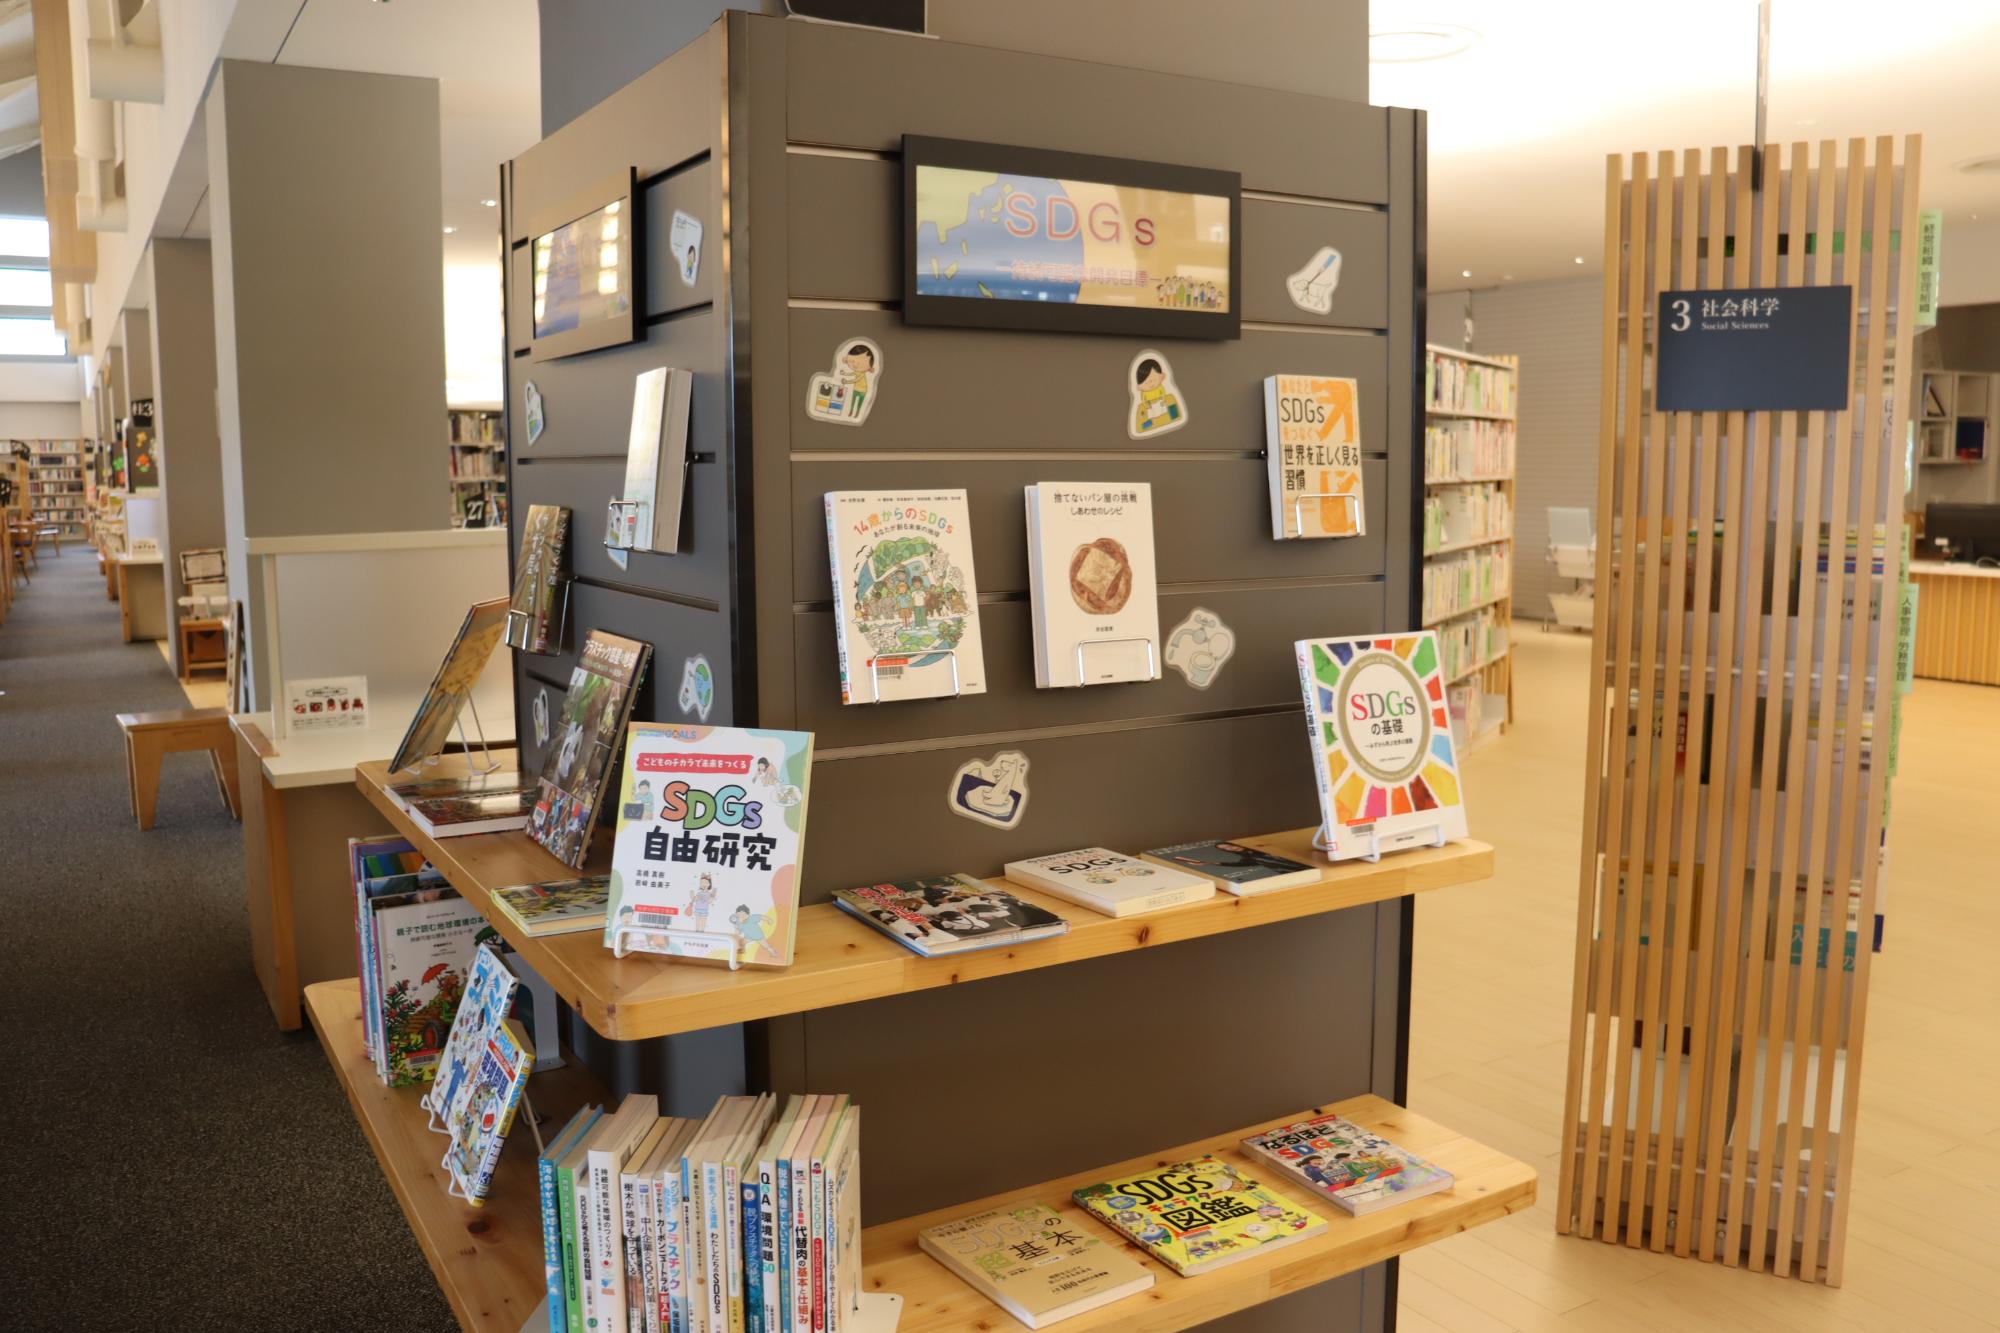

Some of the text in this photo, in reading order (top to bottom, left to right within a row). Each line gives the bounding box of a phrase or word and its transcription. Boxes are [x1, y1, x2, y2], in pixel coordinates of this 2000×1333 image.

[1004, 192, 1157, 247] SDGs
[1670, 299, 1692, 332] 3
[1701, 297, 1780, 318] 社会科学
[1701, 321, 1769, 331] Social Sciences
[1281, 398, 1325, 424] SDGs
[1284, 444, 1359, 467] 世界を正しく見る
[1286, 469, 1306, 491] 習慣
[467, 501, 484, 520] 27
[1054, 492, 1137, 503] 捨てないパン屋の挑戦
[854, 507, 954, 535] 14歳からのSDGs
[1071, 507, 1123, 516] しあわせのレシピ
[1351, 690, 1416, 721] SDGs
[1371, 718, 1404, 736] の基礎
[643, 758, 747, 769] こどものチカラで未来をつくる
[661, 780, 763, 830] SDGs
[644, 825, 778, 872] 自由研究
[1049, 856, 1128, 875] SDGs
[396, 916, 485, 936] 親子で読む地球環境の本
[1259, 1124, 1337, 1151] なるほど
[1277, 1137, 1348, 1160] SDGs
[1116, 1173, 1214, 1206] SDGs
[1147, 1189, 1224, 1213] キャラクター
[600, 1168, 613, 1257] 持続可能な地域のつくり方
[1160, 1196, 1257, 1231] 図鑑
[760, 1211, 774, 1262] 環境問題
[657, 1219, 669, 1292] カーボンニュートラル
[667, 1221, 681, 1290] プラスチック
[795, 1226, 809, 1325] 代替肉の基本と仕組み
